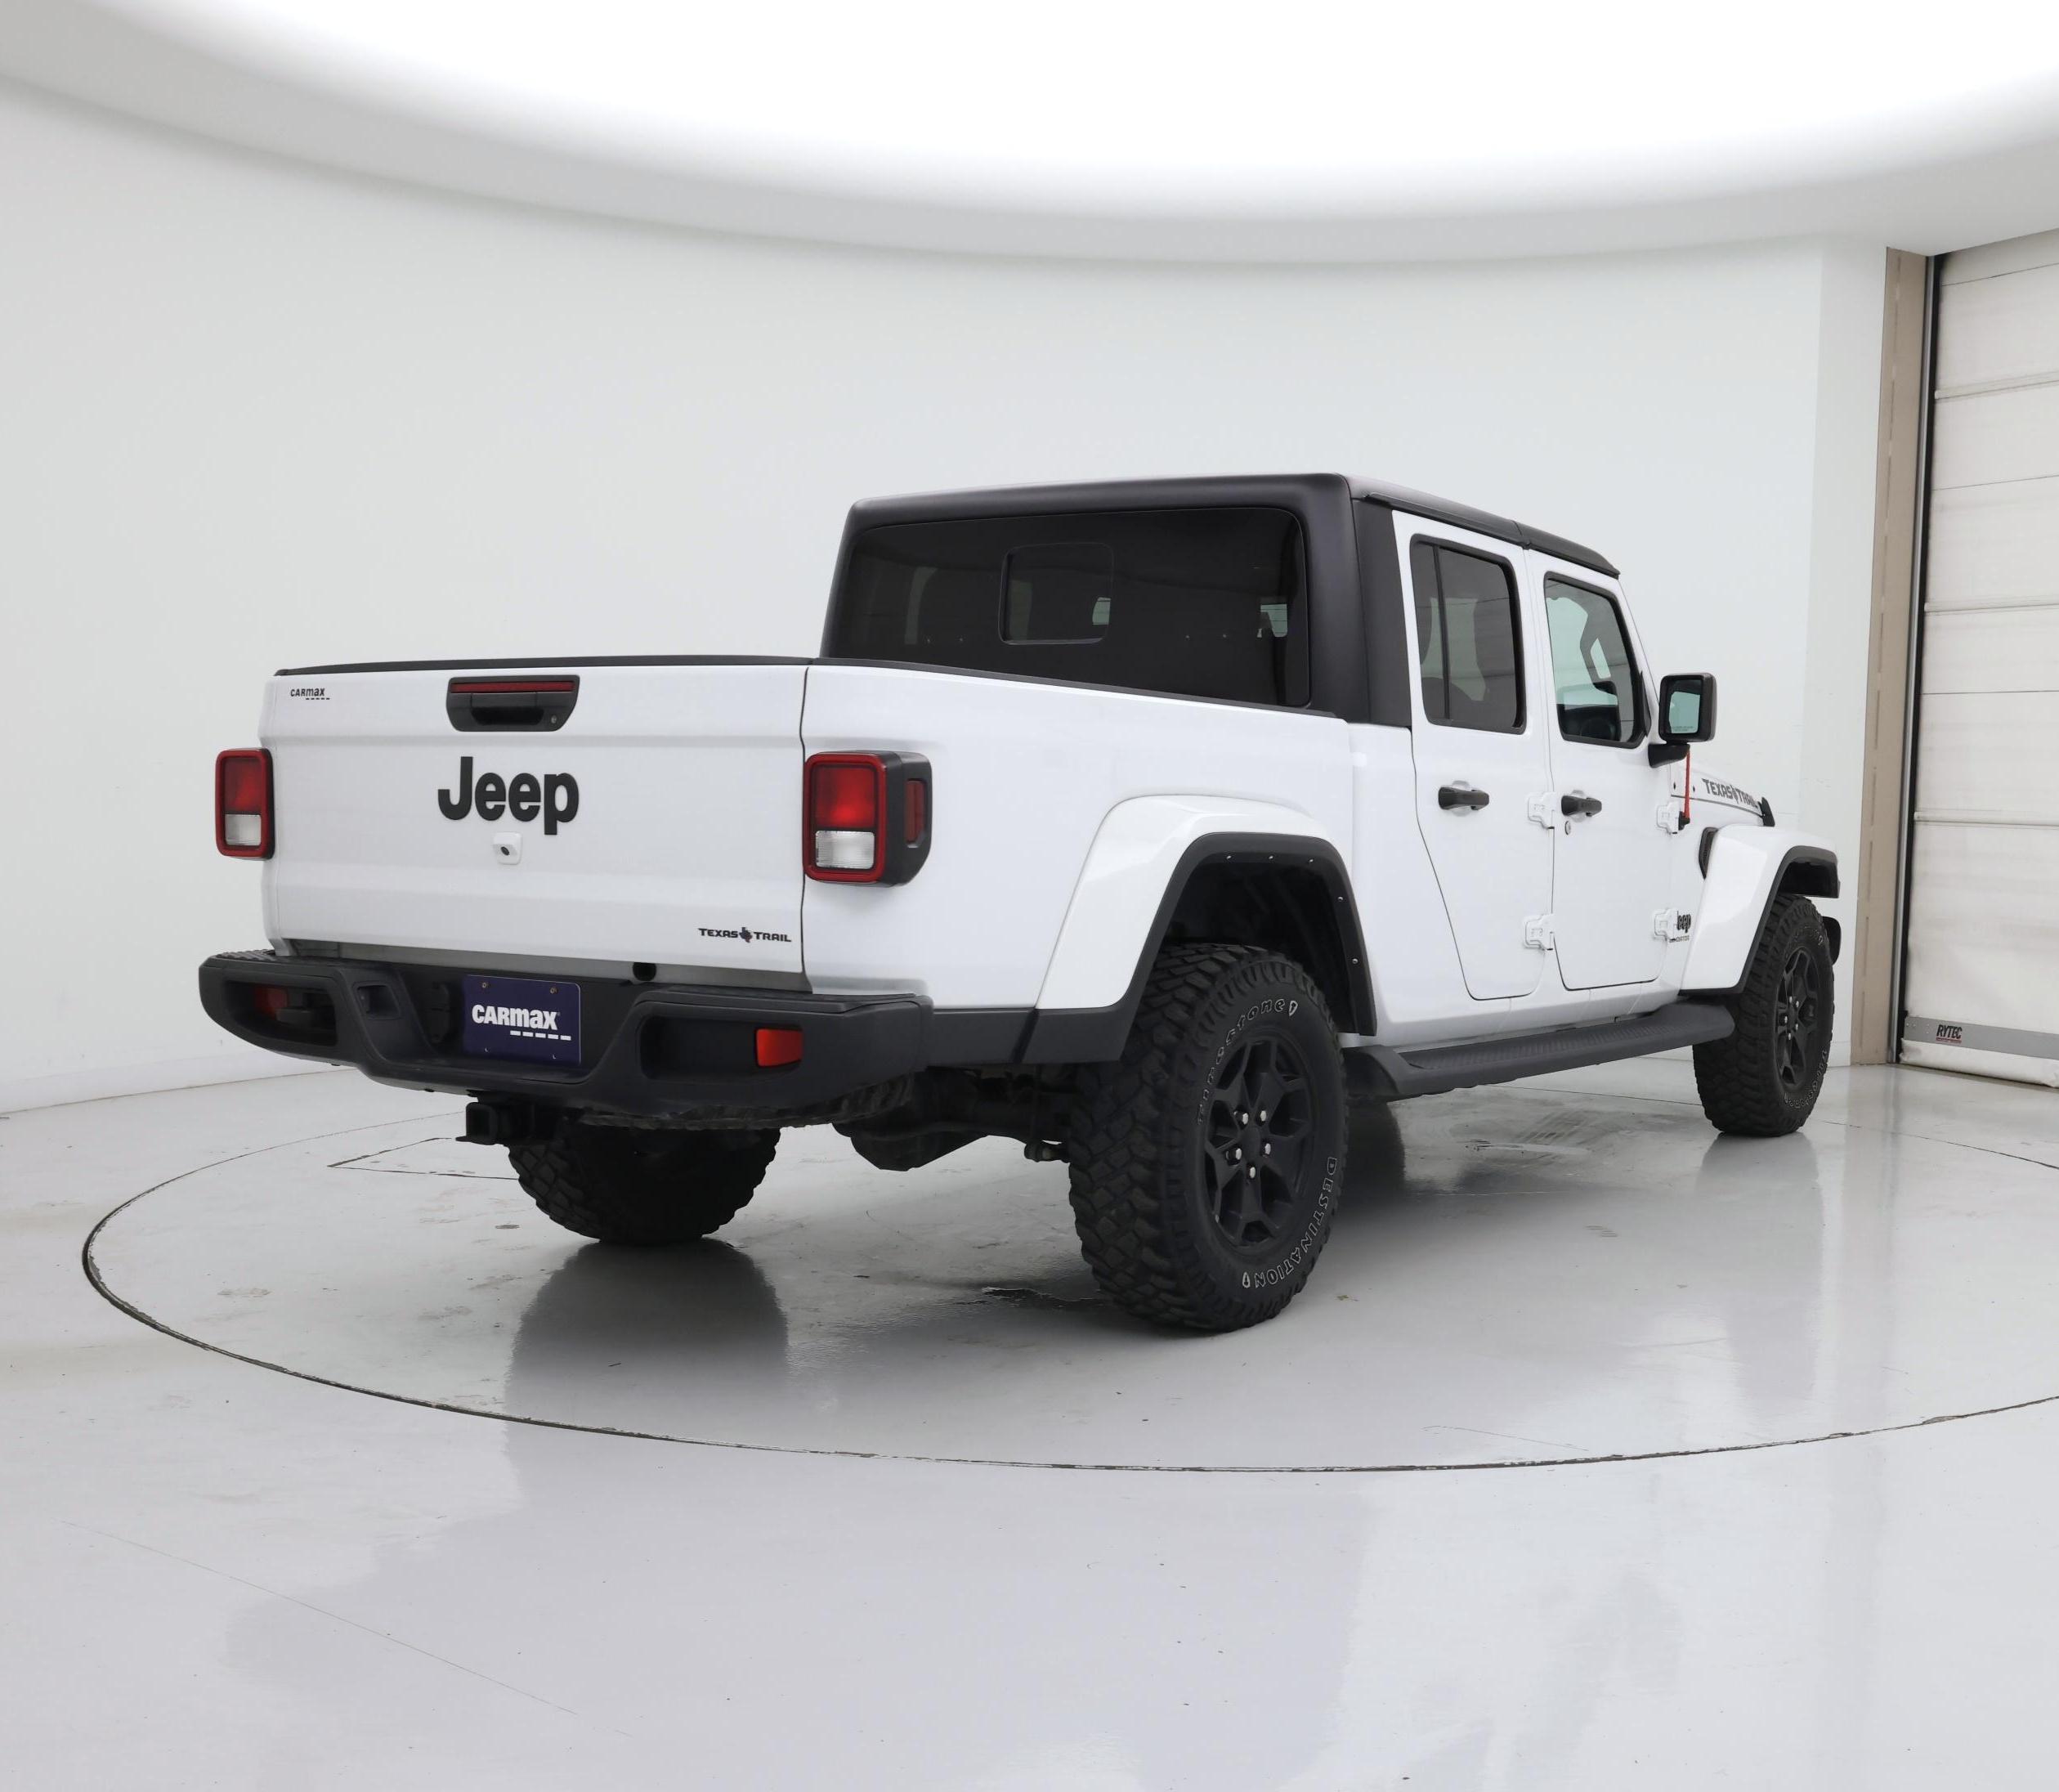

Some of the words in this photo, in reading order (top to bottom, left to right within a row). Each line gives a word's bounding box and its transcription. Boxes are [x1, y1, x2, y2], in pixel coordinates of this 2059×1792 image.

[438, 756, 579, 836] Jeep
[1702, 778, 1732, 800] TEXAS
[698, 928, 738, 939] TEXAS
[753, 931, 792, 943] TRAIL
[1936, 1024, 1963, 1039] RYTEC
[1254, 1157, 1338, 1289] DESTINATION
